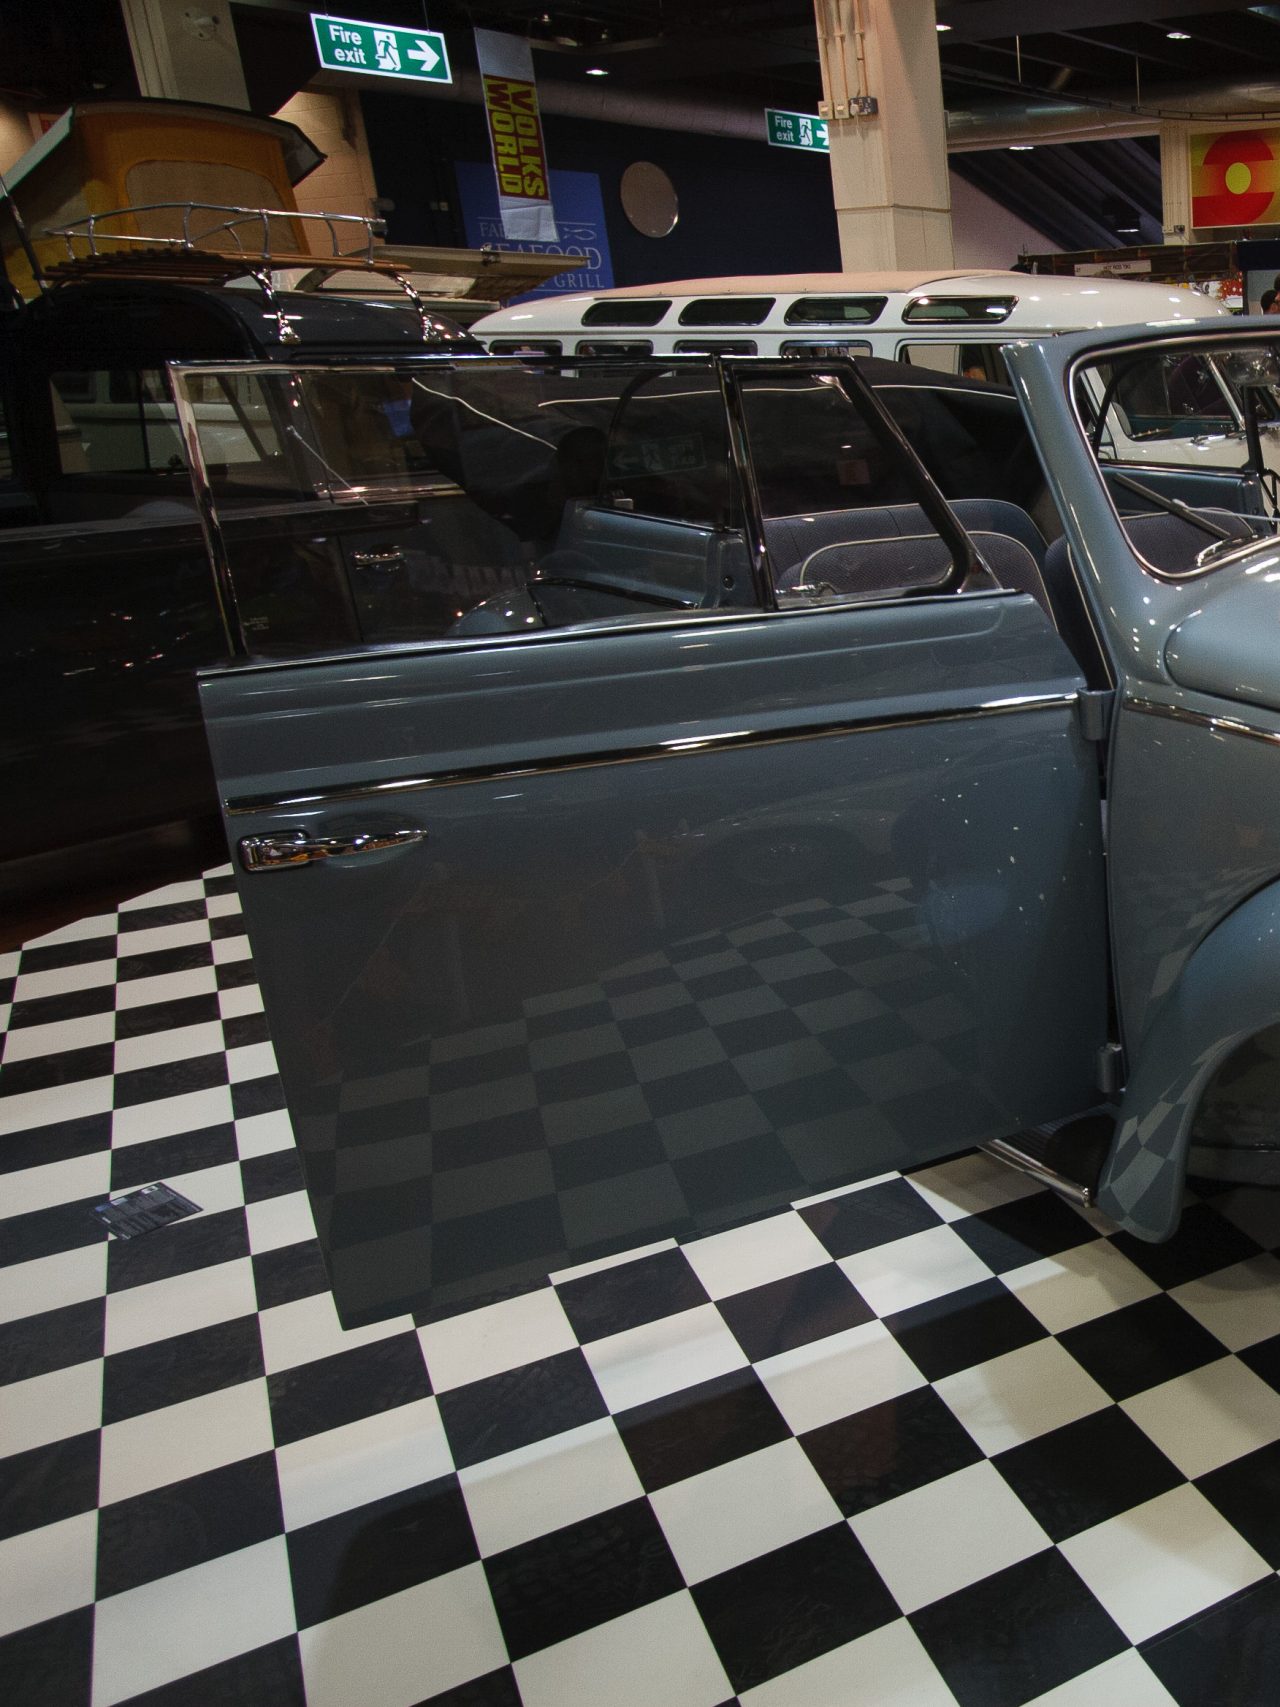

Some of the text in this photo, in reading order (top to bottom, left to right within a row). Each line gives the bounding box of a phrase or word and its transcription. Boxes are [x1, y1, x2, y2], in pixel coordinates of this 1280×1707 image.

[329, 24, 362, 45] Fire
[334, 48, 367, 65] exit
[774, 115, 793, 129] Fire
[486, 83, 524, 195] WORLD
[511, 83, 545, 198] VOLKS
[776, 130, 795, 142] exit
[553, 272, 605, 289] GRILL
